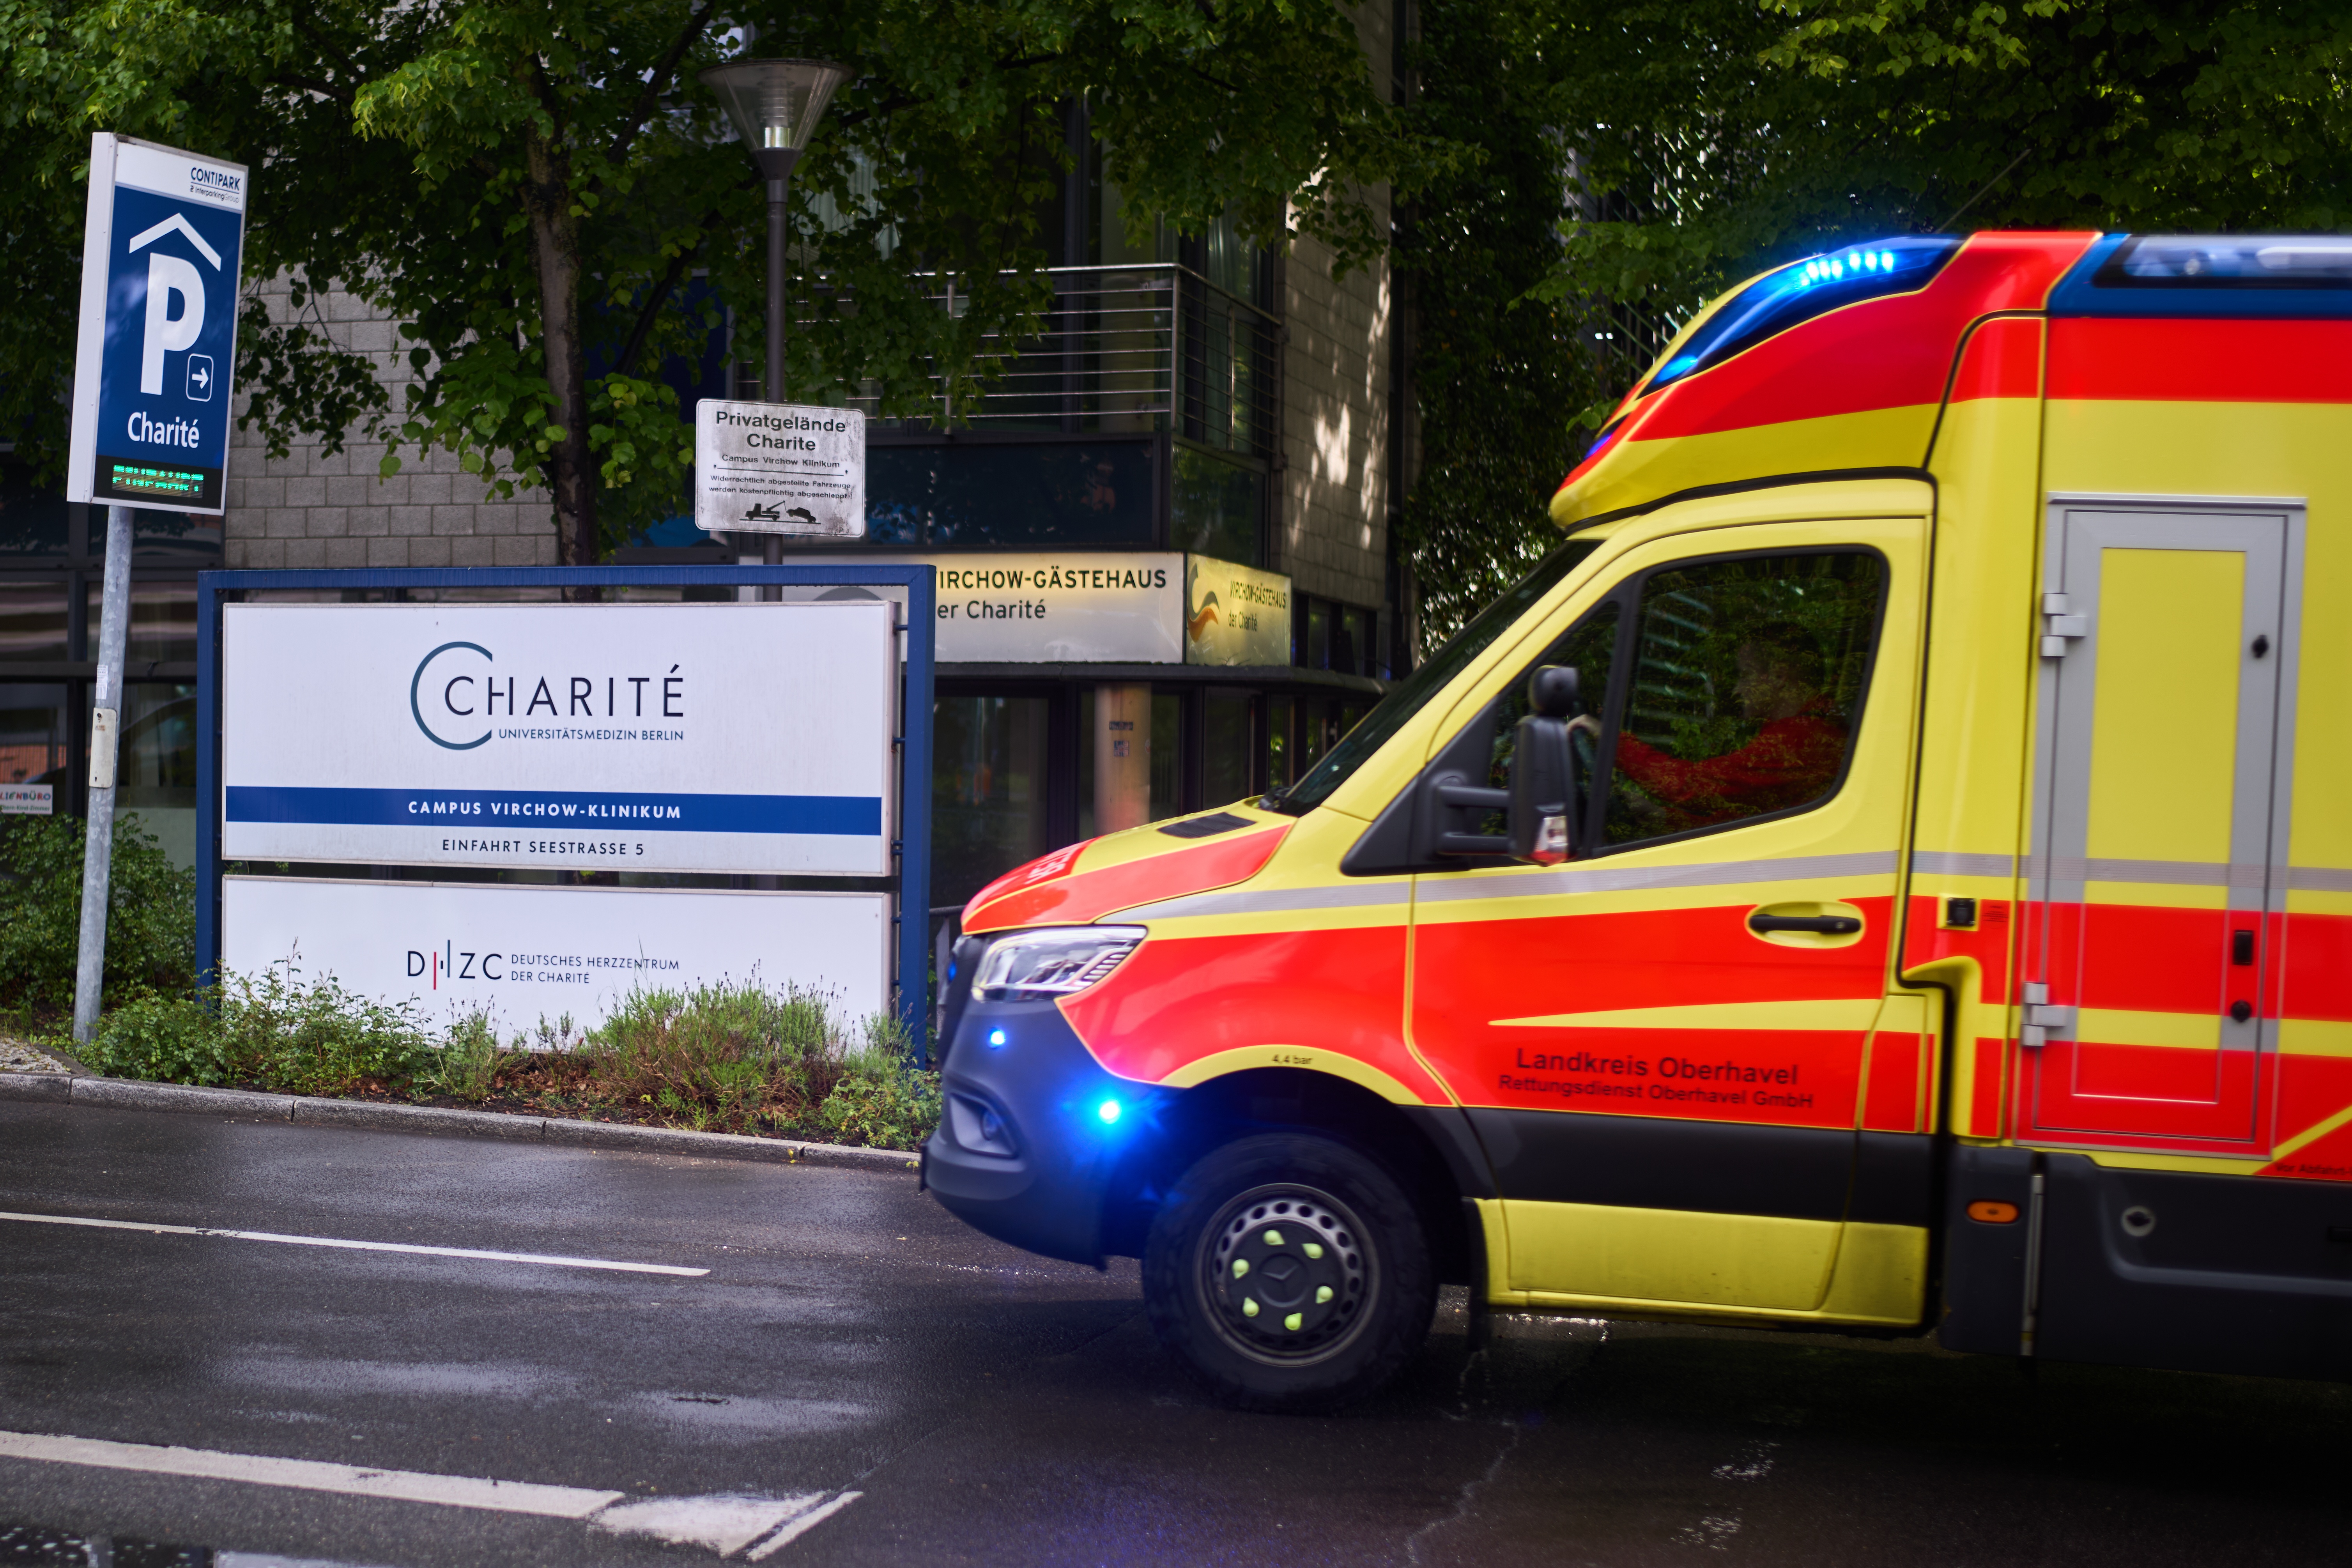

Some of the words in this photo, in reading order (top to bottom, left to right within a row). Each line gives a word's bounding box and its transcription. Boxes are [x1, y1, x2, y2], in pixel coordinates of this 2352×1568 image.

[191, 167, 241, 191] CONTIPARK
[140, 253, 205, 395] P
[127, 411, 200, 448] Charité
[717, 411, 845, 432] Privatgelände
[747, 434, 815, 451] Charite
[722, 454, 758, 463] Campus
[763, 457, 798, 465] Virchow
[740, 488, 794, 497] kostenpflichtig
[798, 491, 847, 500] abgeschleppt
[813, 481, 850, 490] Fahrzeuge
[936, 566, 1166, 588] IRCHOW-GÄSTEHAUS
[1230, 580, 1287, 609] VIRCHOW-GÄSTEHAUS
[937, 605, 958, 619] er
[967, 599, 1045, 619] Charité
[1228, 609, 1237, 627] der
[1238, 611, 1257, 632] Charité
[499, 728, 636, 740] UNIVERSITÄTSMEDIZIN
[642, 731, 683, 740] BERLIN
[409, 801, 481, 814] CAMPUS
[491, 803, 680, 818] VIRCHOW-KLINIKUM
[443, 840, 520, 852] EINFAHRT
[529, 841, 626, 854] SEESTRASSE
[636, 844, 643, 855] 5
[512, 954, 581, 966] DEUTSCHES
[588, 957, 678, 970] HERZZENTRUM
[512, 971, 532, 981] DER
[538, 972, 589, 983] CHARITÉ
[1292, 1055, 1313, 1064] bar
[1518, 1049, 1648, 1076] Landkreis
[1659, 1057, 1797, 1084] Oberhavel
[1500, 1075, 1642, 1098] Rettungsdienst
[1649, 1085, 1745, 1104] Oberhavel
[1754, 1091, 1812, 1107] GmbH
